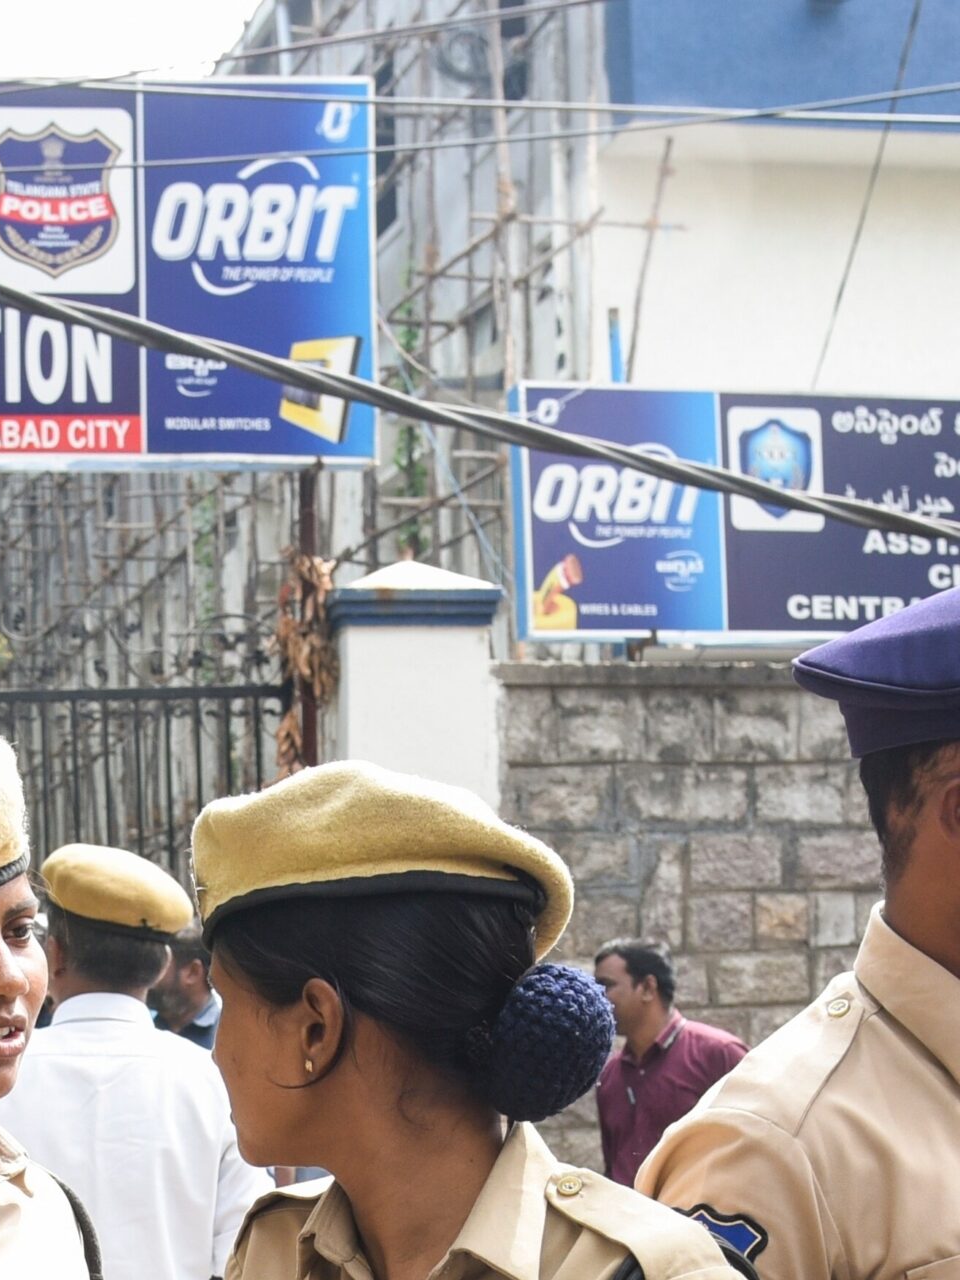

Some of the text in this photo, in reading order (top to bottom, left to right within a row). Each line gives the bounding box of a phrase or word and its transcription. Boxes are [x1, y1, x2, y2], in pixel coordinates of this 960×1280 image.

[0, 194, 110, 222] POLICE
[152, 181, 359, 263] ORBIT
[67, 419, 131, 450] CITY
[164, 417, 271, 431] MODULAR SWITCHES
[620, 604, 658, 616] CABLES
[786, 594, 922, 621] CENTR
